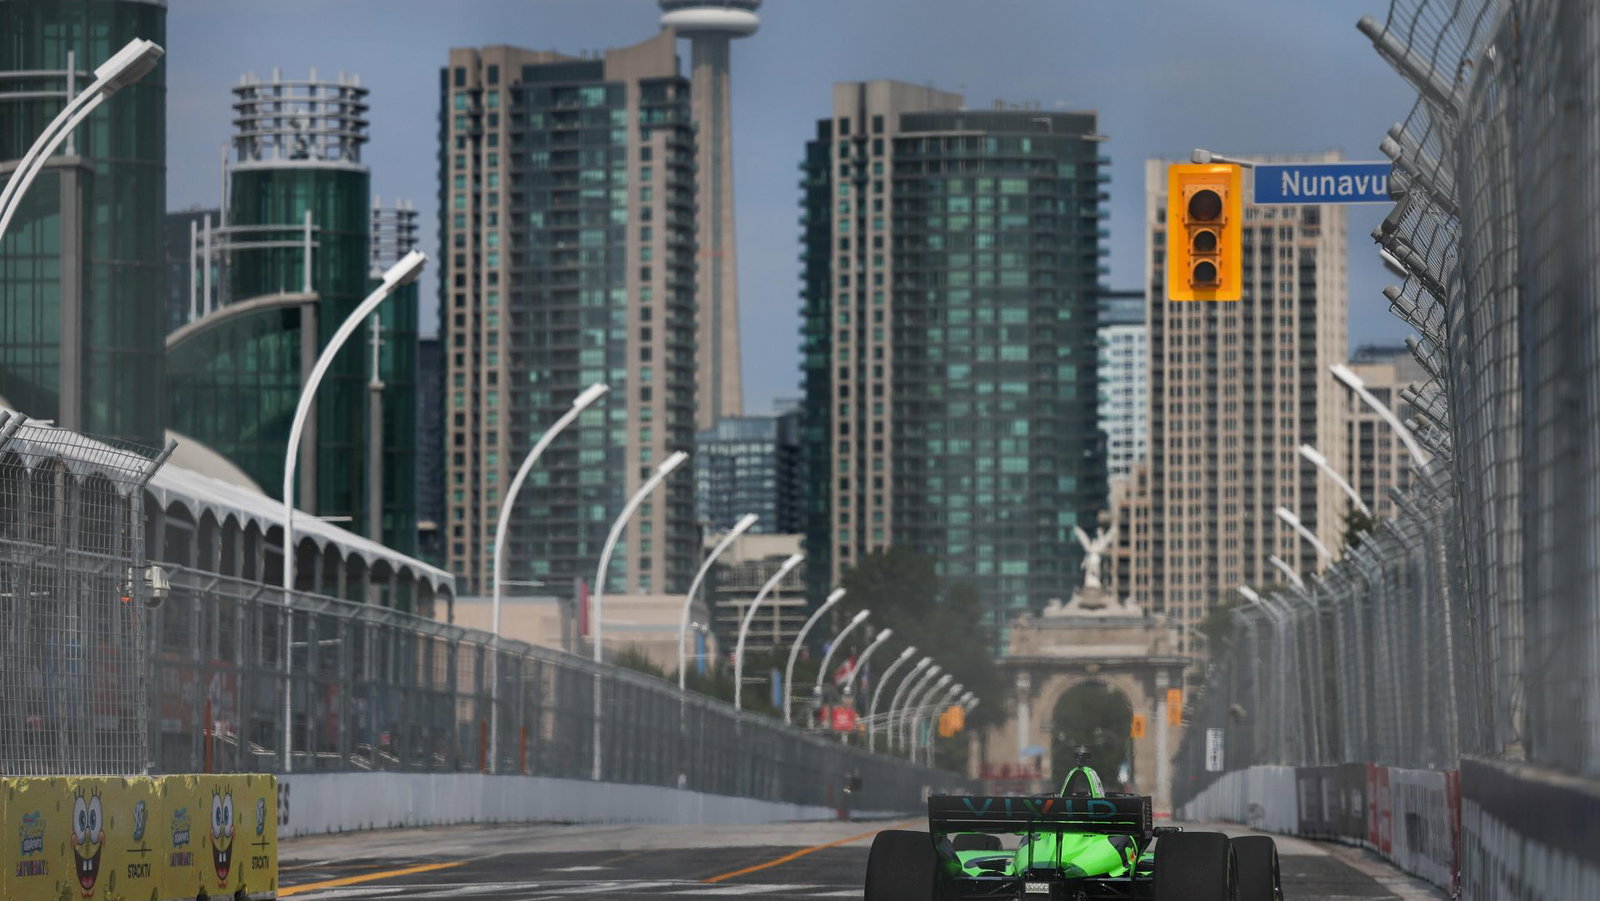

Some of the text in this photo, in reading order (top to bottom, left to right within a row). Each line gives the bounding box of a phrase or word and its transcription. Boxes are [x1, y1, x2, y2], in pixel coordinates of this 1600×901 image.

[1281, 170, 1388, 196] Nunavu
[962, 797, 1118, 818] VIVID
[127, 863, 152, 880] STACKTV
